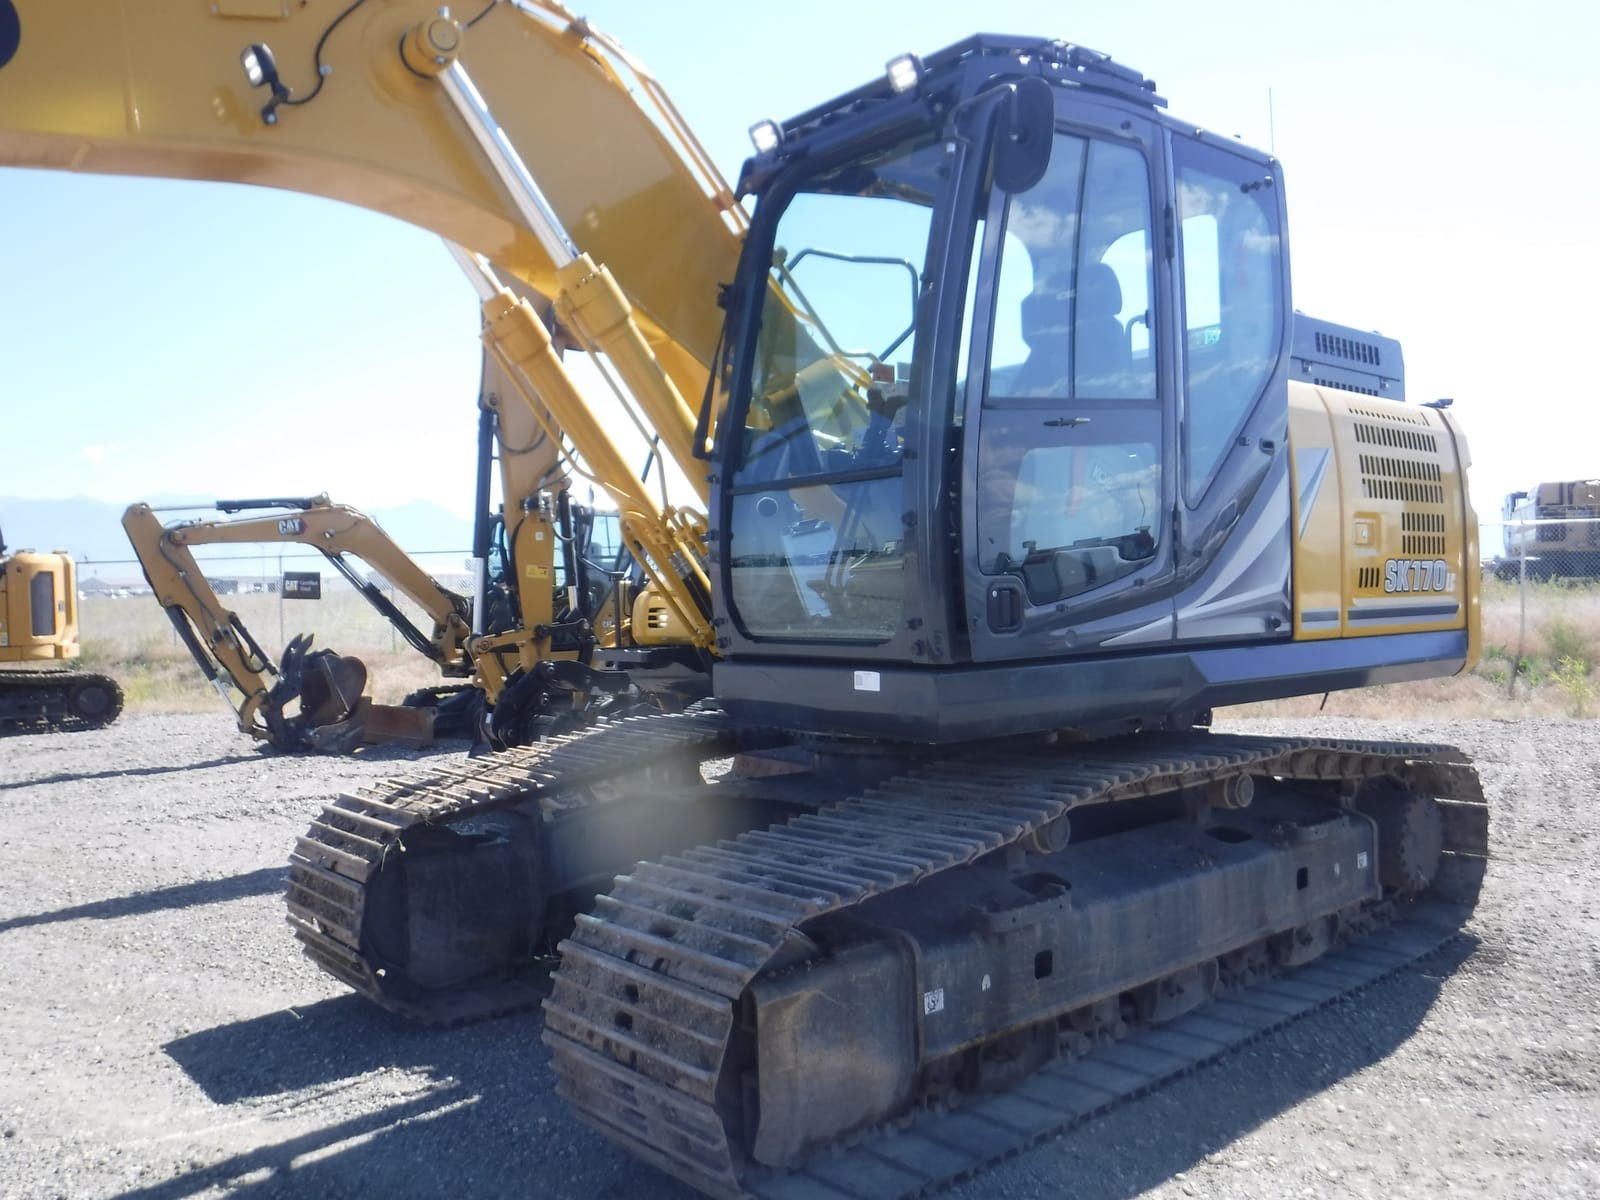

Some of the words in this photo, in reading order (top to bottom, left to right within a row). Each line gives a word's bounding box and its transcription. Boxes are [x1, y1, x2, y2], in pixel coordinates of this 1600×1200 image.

[279, 518, 300, 534] CAT
[1384, 558, 1447, 593] SK170
[285, 580, 299, 592] CAT
